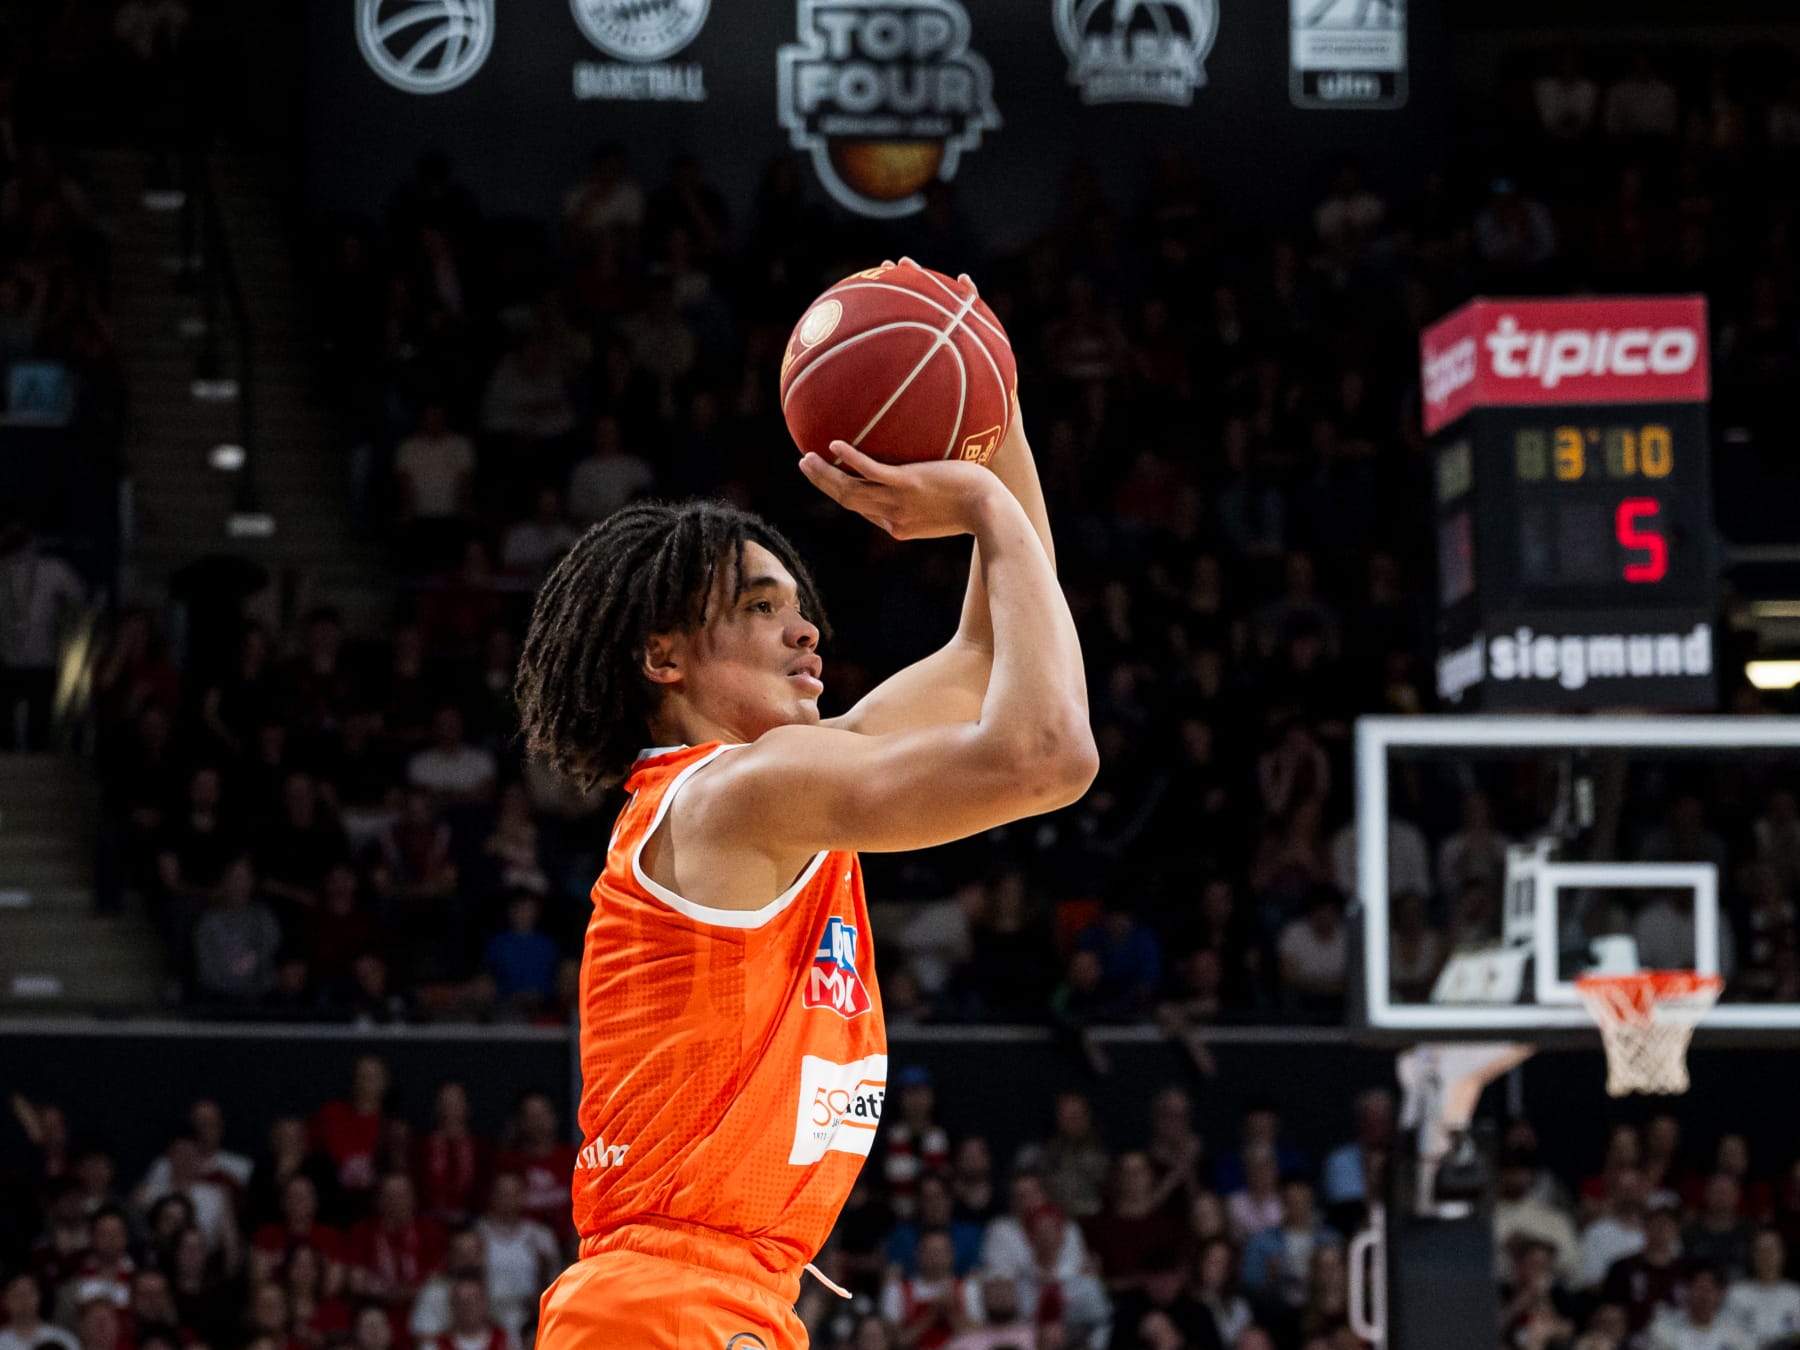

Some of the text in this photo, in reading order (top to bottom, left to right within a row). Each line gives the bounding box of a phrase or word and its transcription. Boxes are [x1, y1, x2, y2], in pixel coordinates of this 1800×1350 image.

[815, 10, 953, 60] TOP
[798, 61, 974, 114] FOUR
[1486, 312, 1699, 389] tipico
[1613, 496, 1669, 584] 5
[1488, 622, 1713, 691] siegmund
